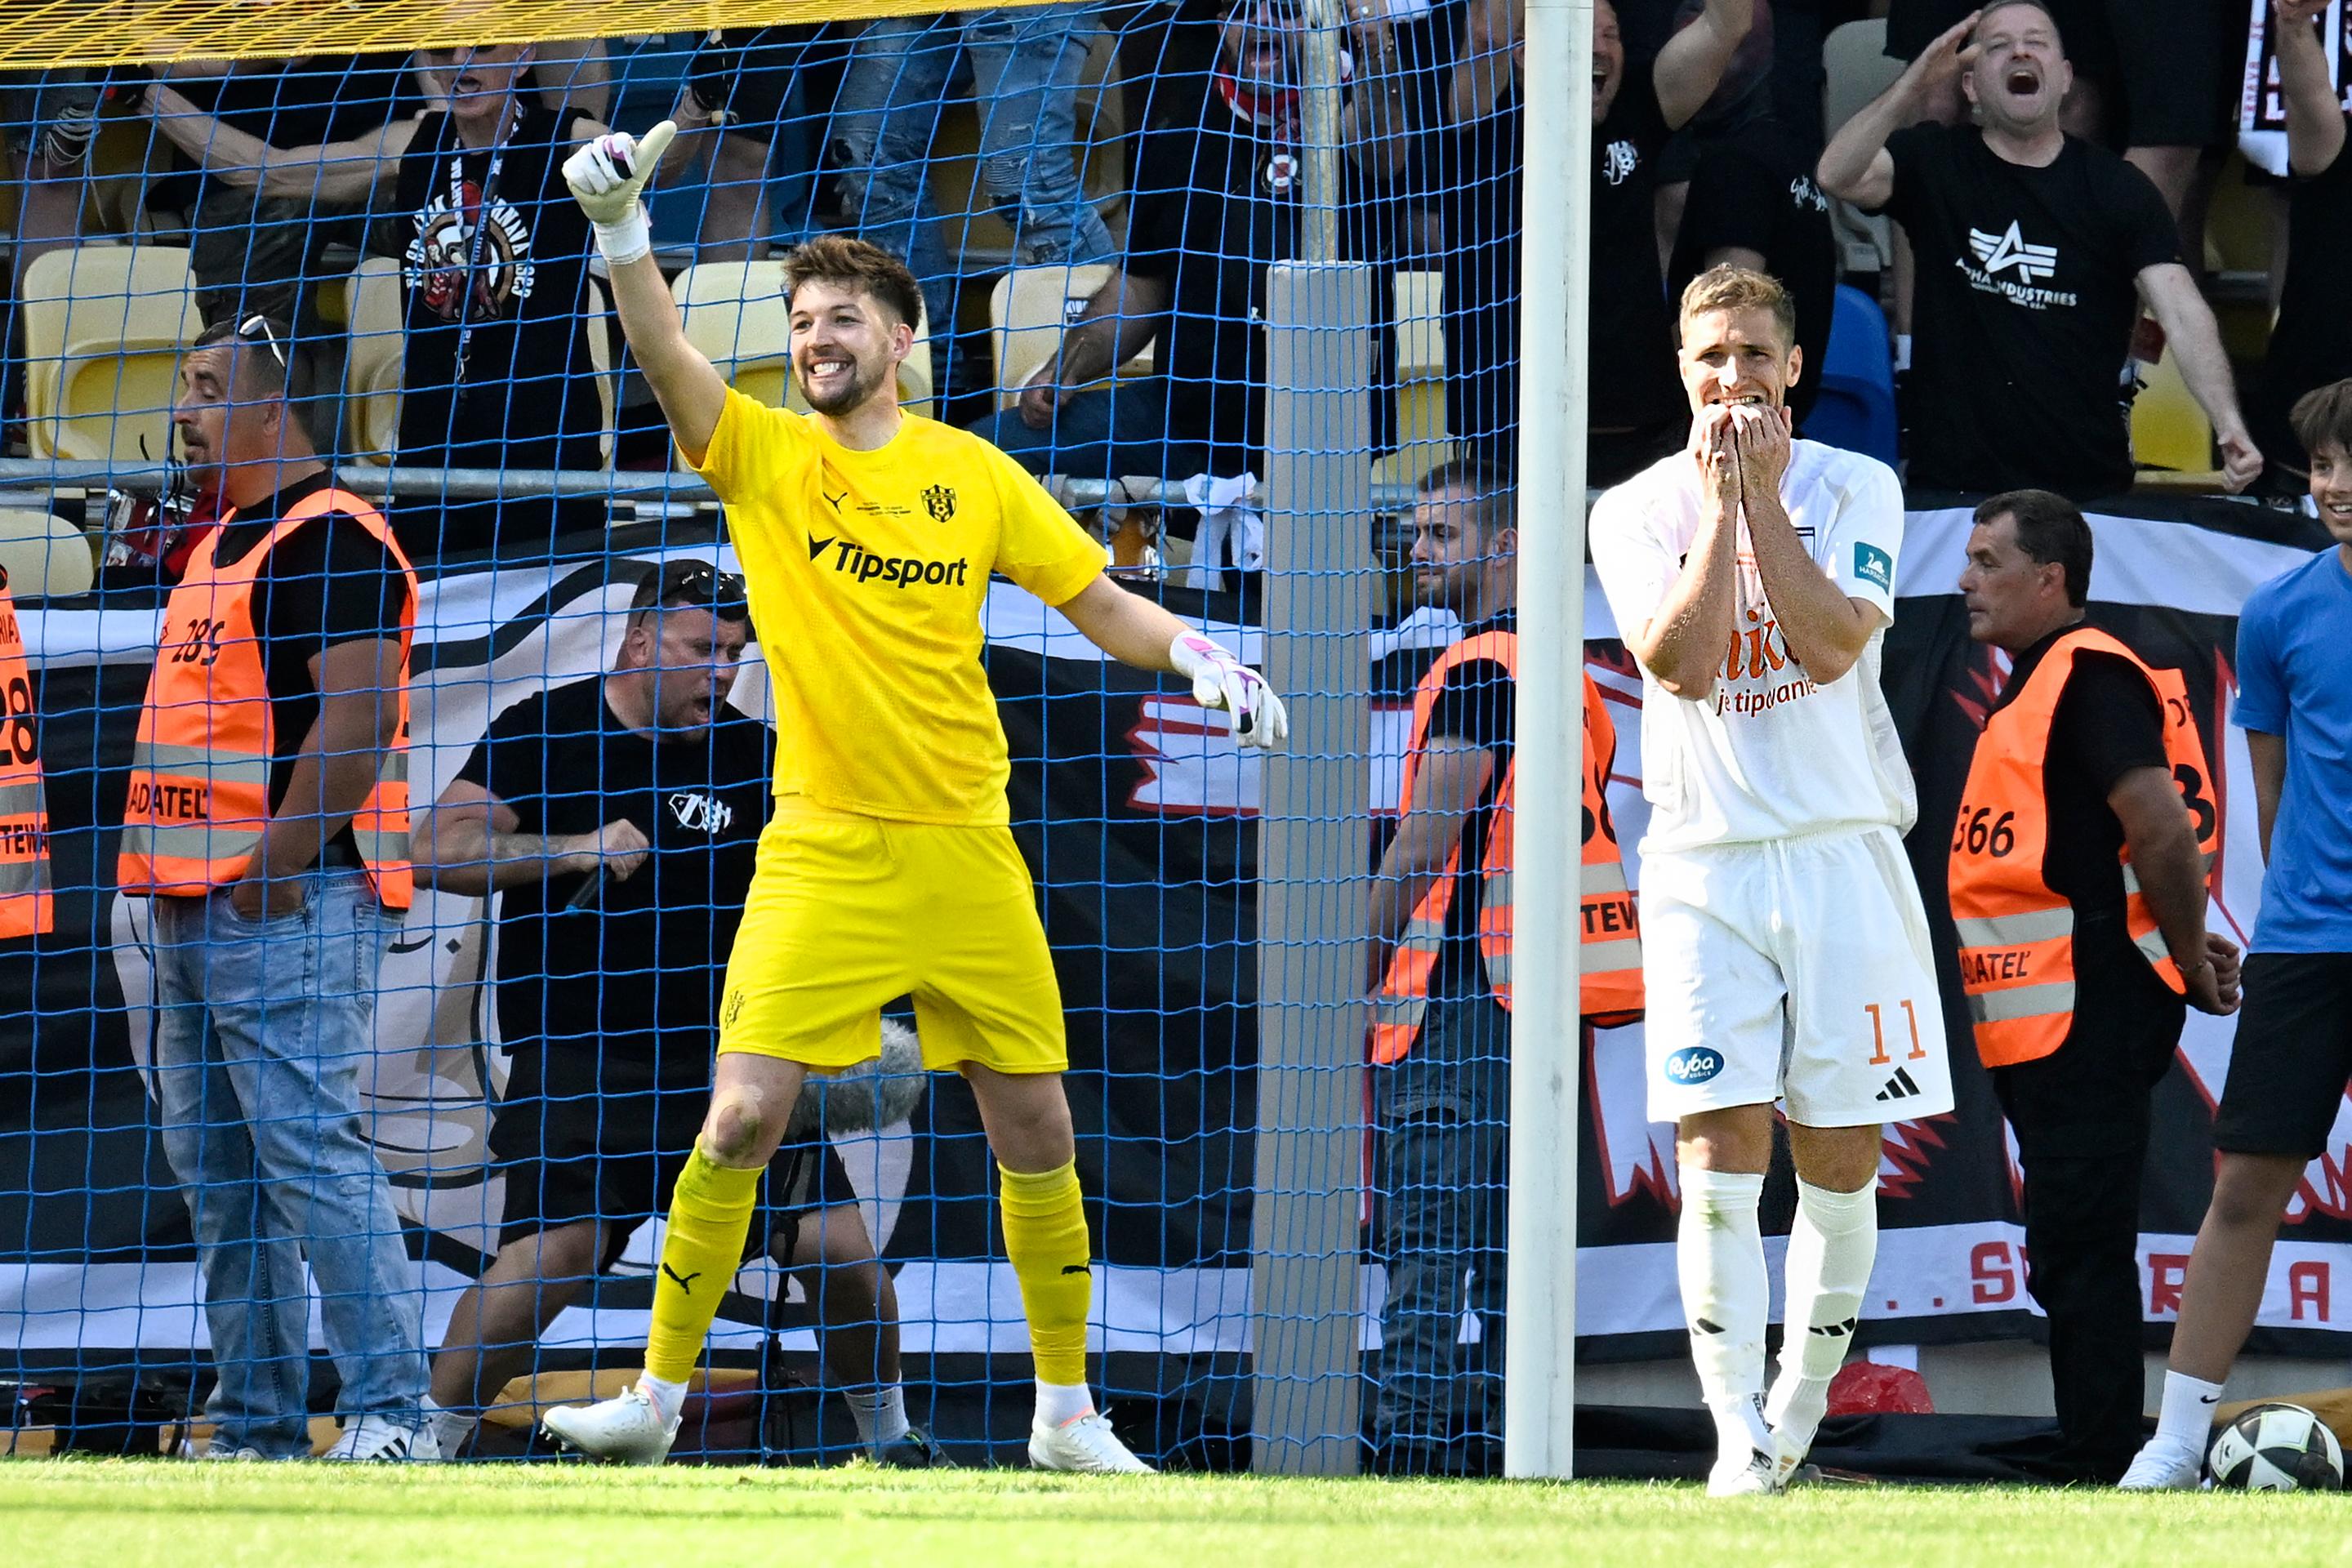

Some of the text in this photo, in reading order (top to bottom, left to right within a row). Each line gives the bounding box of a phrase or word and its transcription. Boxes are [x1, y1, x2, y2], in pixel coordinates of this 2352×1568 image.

[835, 541, 968, 589] Tipsport
[1716, 688, 1731, 717] je
[1864, 999, 1927, 1066] 11
[1668, 1054, 1714, 1079] Ryba
